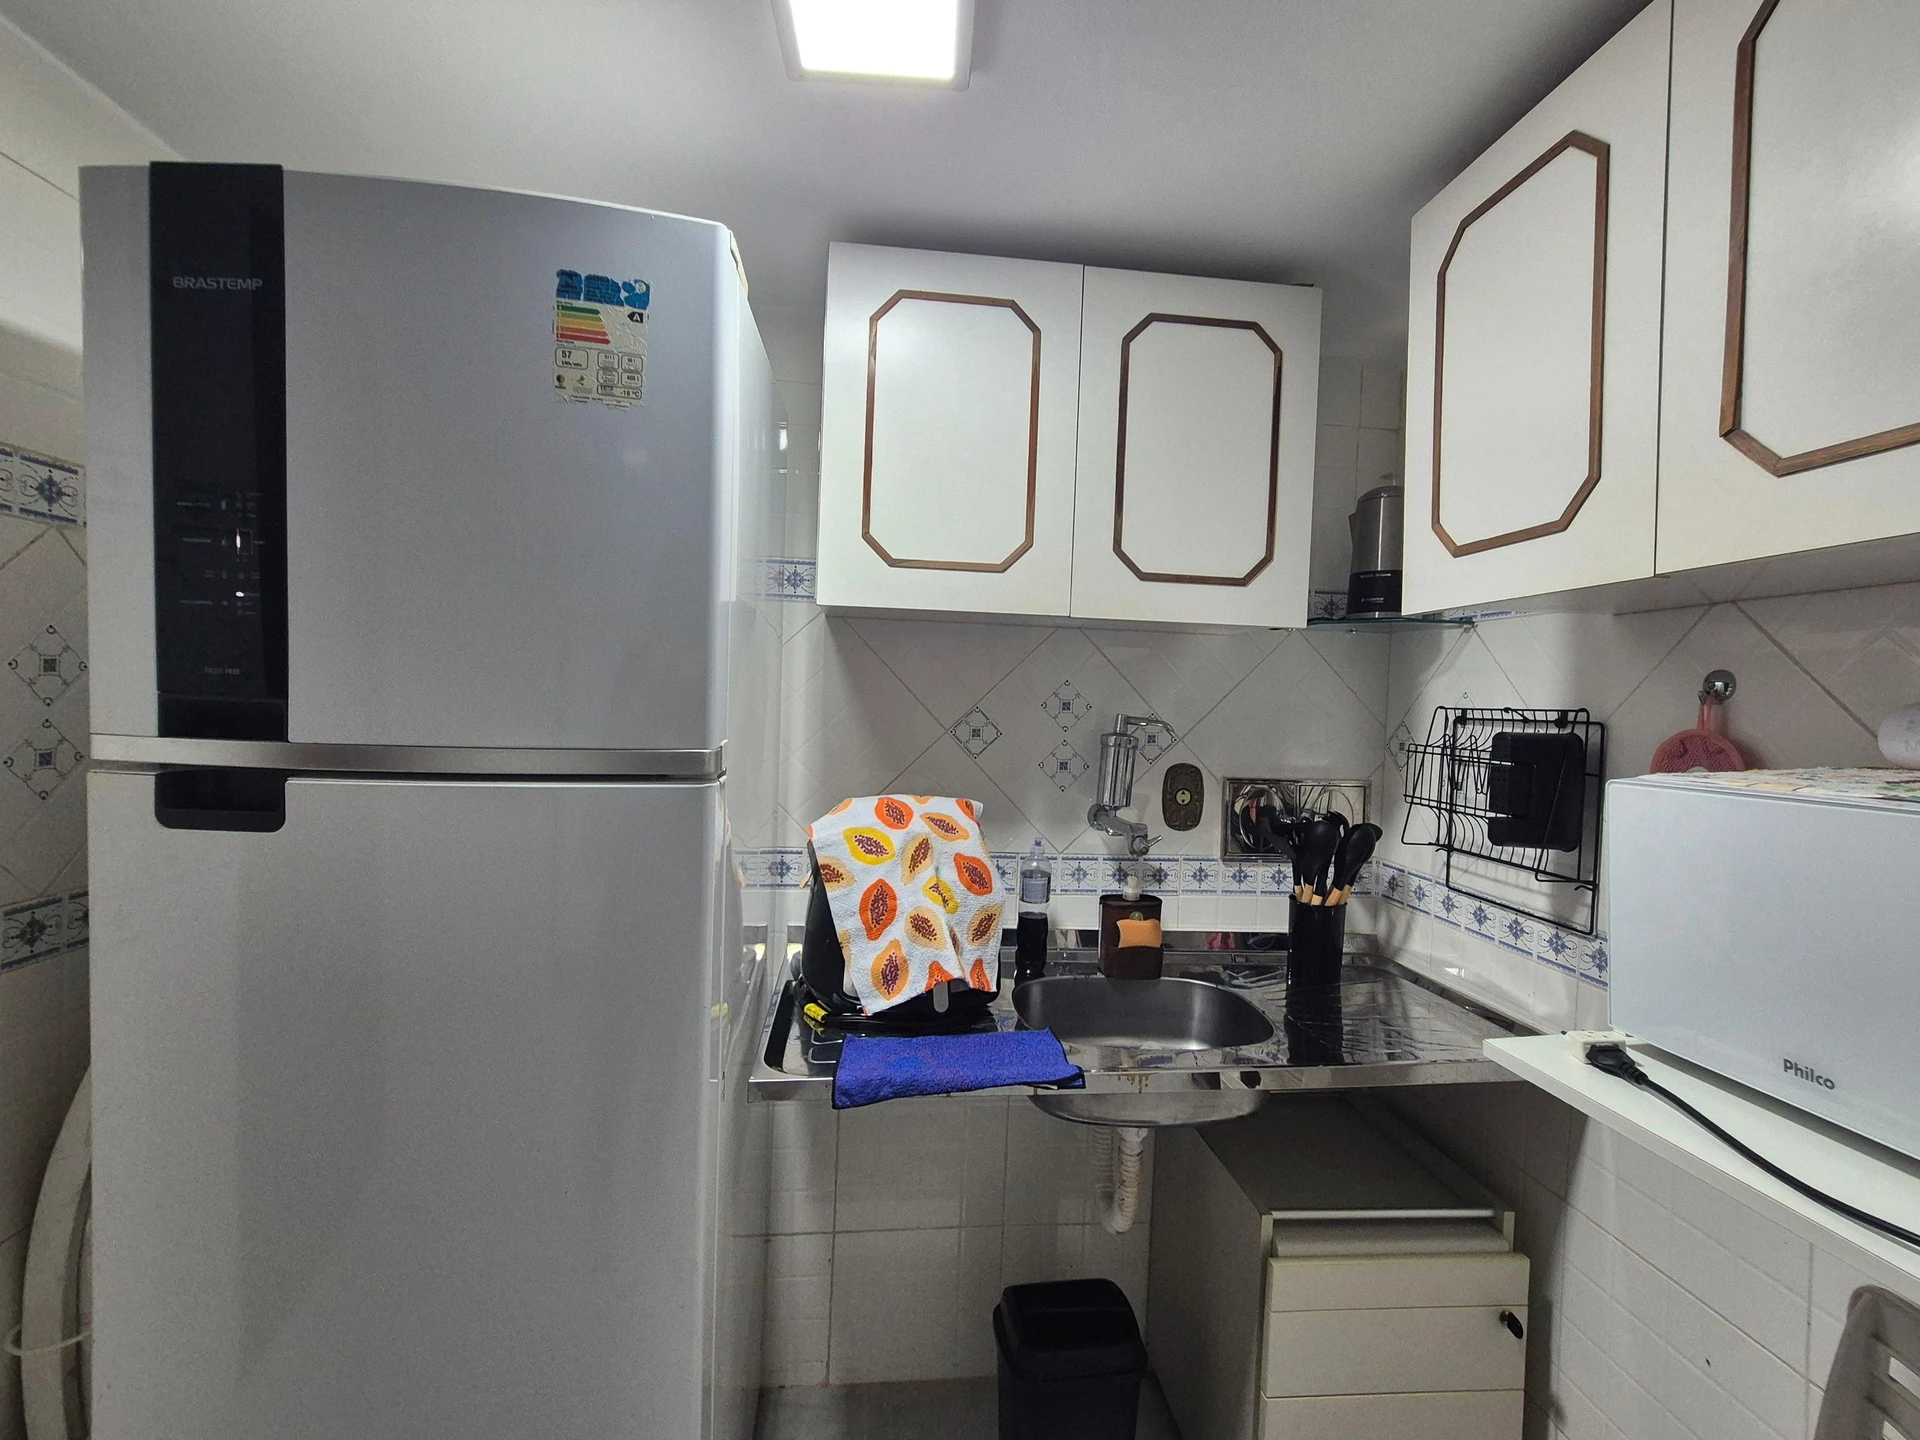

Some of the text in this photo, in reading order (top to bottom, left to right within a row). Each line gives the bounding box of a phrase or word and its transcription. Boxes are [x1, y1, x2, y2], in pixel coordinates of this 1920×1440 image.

[172, 276, 263, 290] BRASTEMP
[633, 313, 641, 322] A
[561, 350, 572, 359] 57
[1783, 1058, 1836, 1090] Philco
